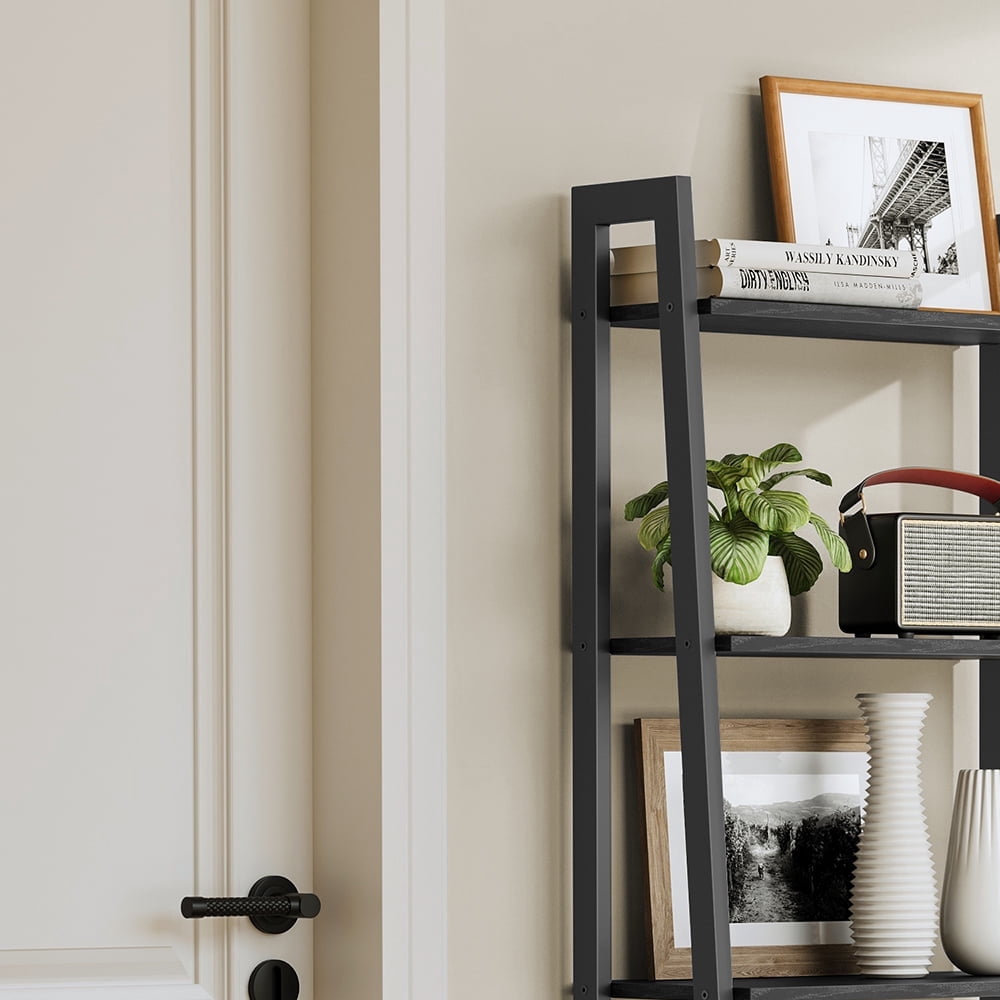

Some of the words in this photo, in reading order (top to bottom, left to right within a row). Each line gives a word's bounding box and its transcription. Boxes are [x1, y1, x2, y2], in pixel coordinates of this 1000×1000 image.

[785, 251, 834, 265] WASSILY
[836, 253, 899, 268] KANDINSKY
[739, 268, 767, 290] DIRTY
[853, 281, 906, 291] MADDEN-MILLS
